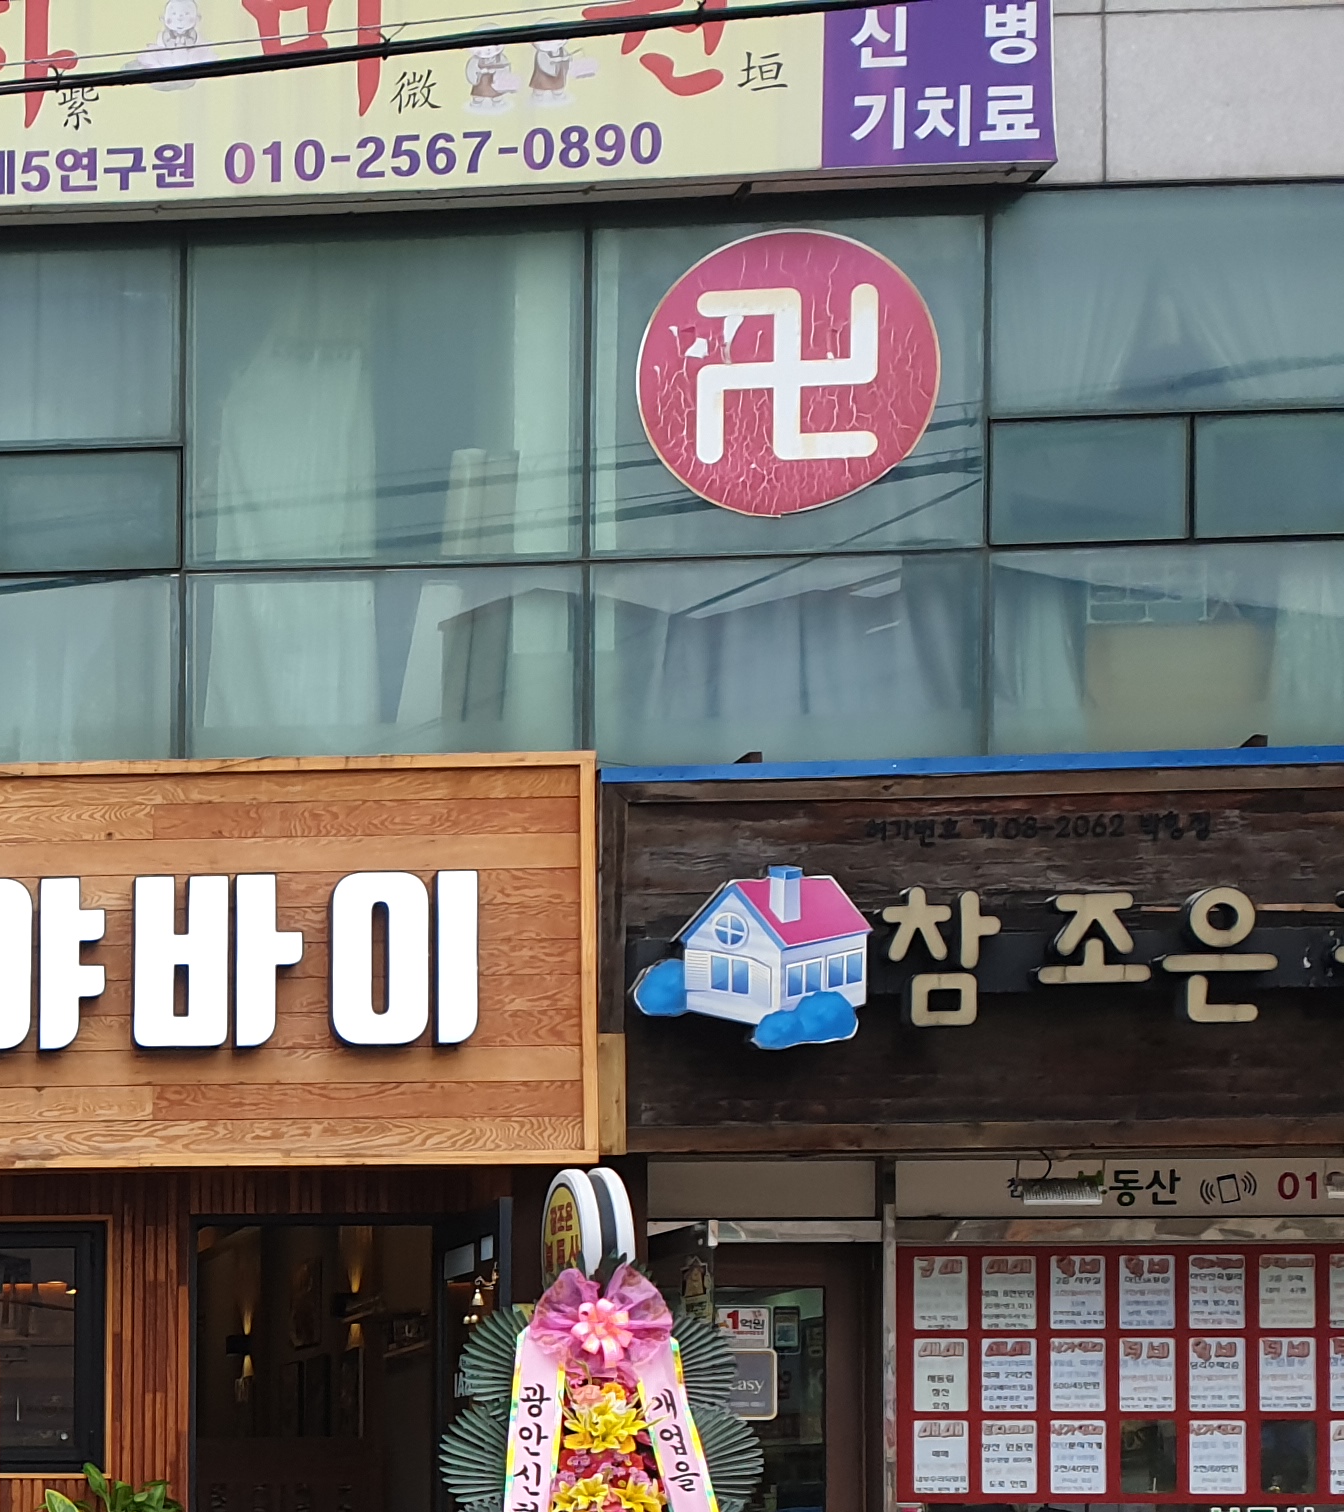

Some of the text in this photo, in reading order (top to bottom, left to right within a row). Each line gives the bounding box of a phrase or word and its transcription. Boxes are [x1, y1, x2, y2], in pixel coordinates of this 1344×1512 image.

[850, 84, 1042, 151] 기치료
[223, 121, 663, 184] 010-2567-0890
[652, 1387, 701, 1493] 개업을
